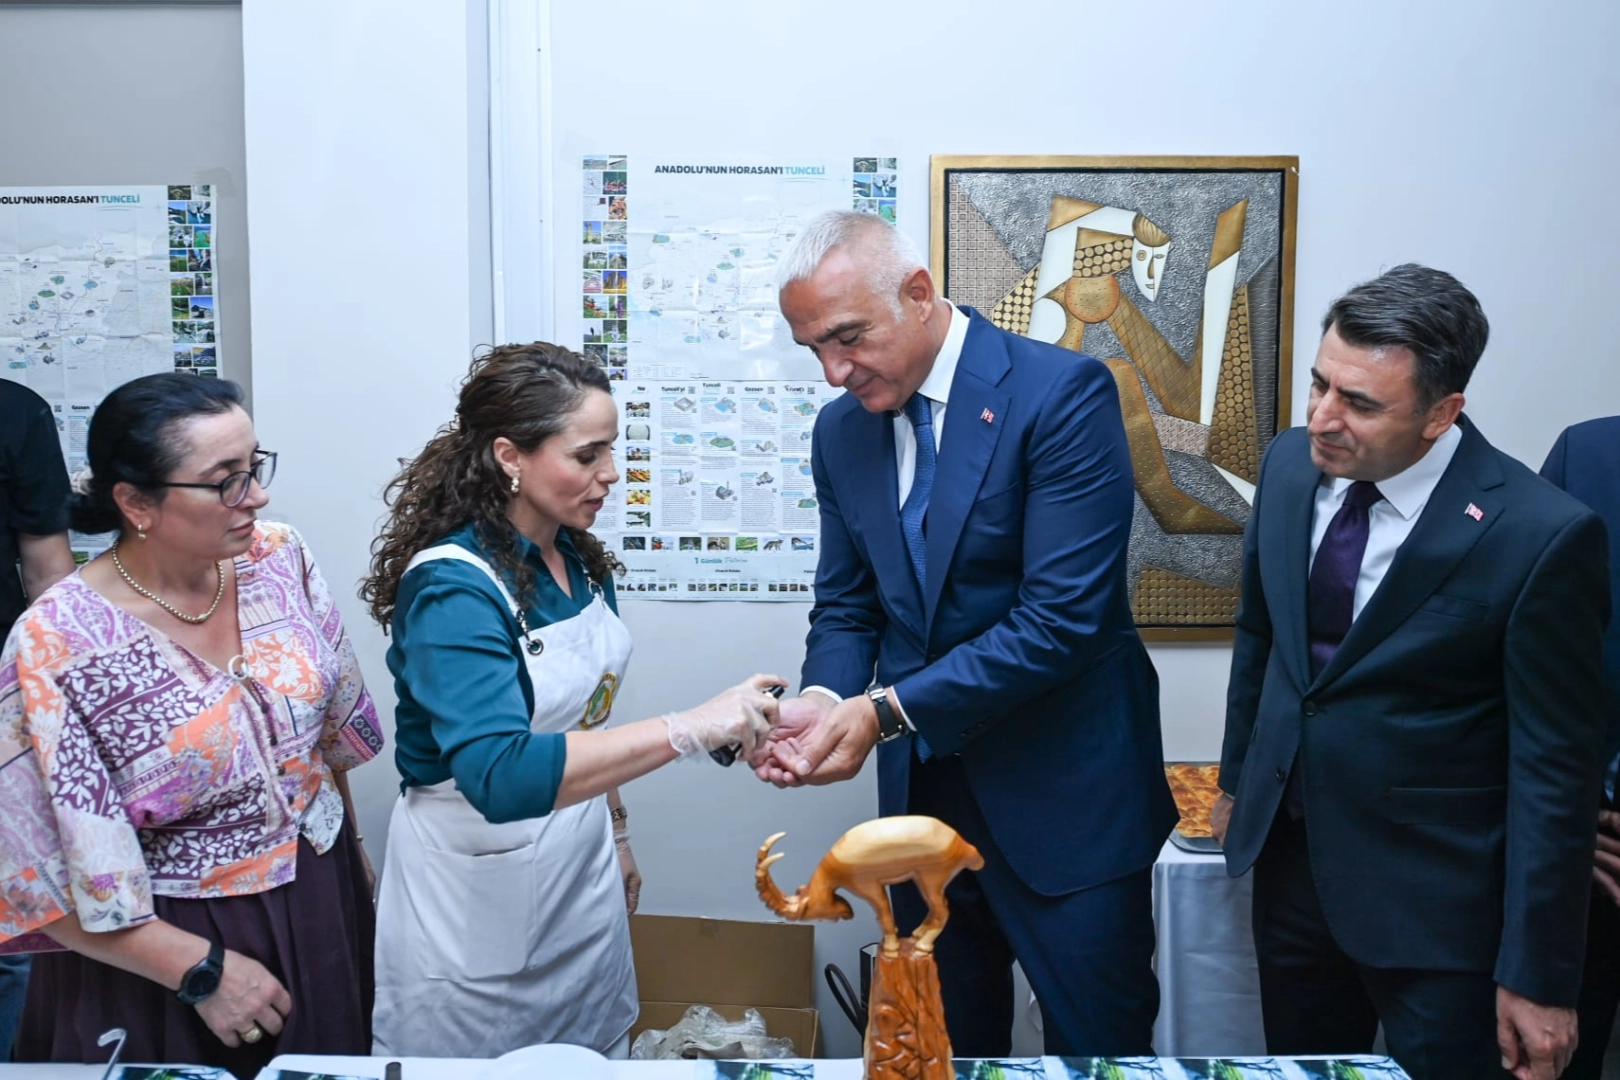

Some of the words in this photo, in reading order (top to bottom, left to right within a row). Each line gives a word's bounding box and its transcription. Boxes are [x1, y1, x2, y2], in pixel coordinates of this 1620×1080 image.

[654, 165, 728, 174] ANADOLU'NUN
[729, 166, 783, 175] HORASAN'I
[785, 165, 826, 175] TUNCELİ
[46, 195, 99, 204] HORASAN'I
[100, 193, 140, 203] TUNCELİ
